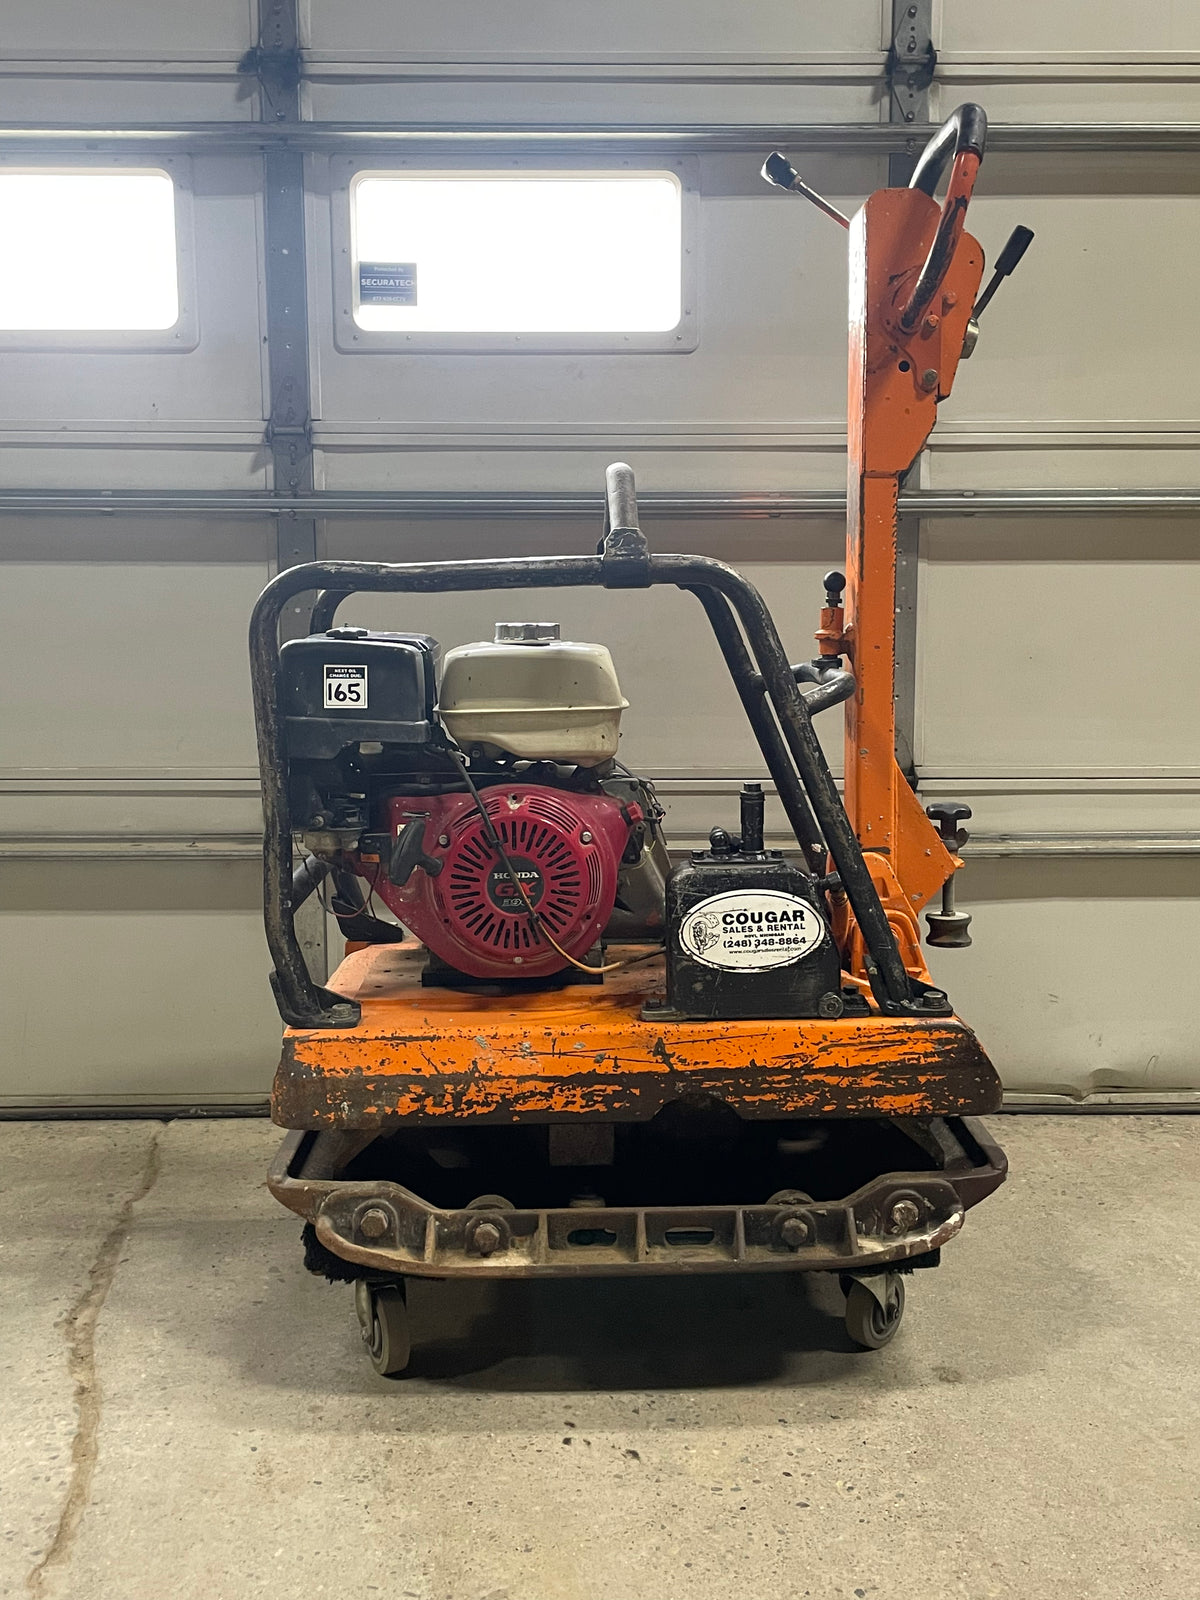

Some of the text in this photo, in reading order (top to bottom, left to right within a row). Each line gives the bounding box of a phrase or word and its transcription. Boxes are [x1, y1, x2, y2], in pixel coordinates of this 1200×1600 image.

[328, 682, 361, 702] 165
[493, 871, 540, 880] HONDA
[495, 882, 537, 896] GX
[722, 910, 805, 926] COUGAR
[722, 926, 753, 934] SALES
[767, 923, 806, 932] RENTAL
[723, 937, 807, 949] (248) 348-8864
